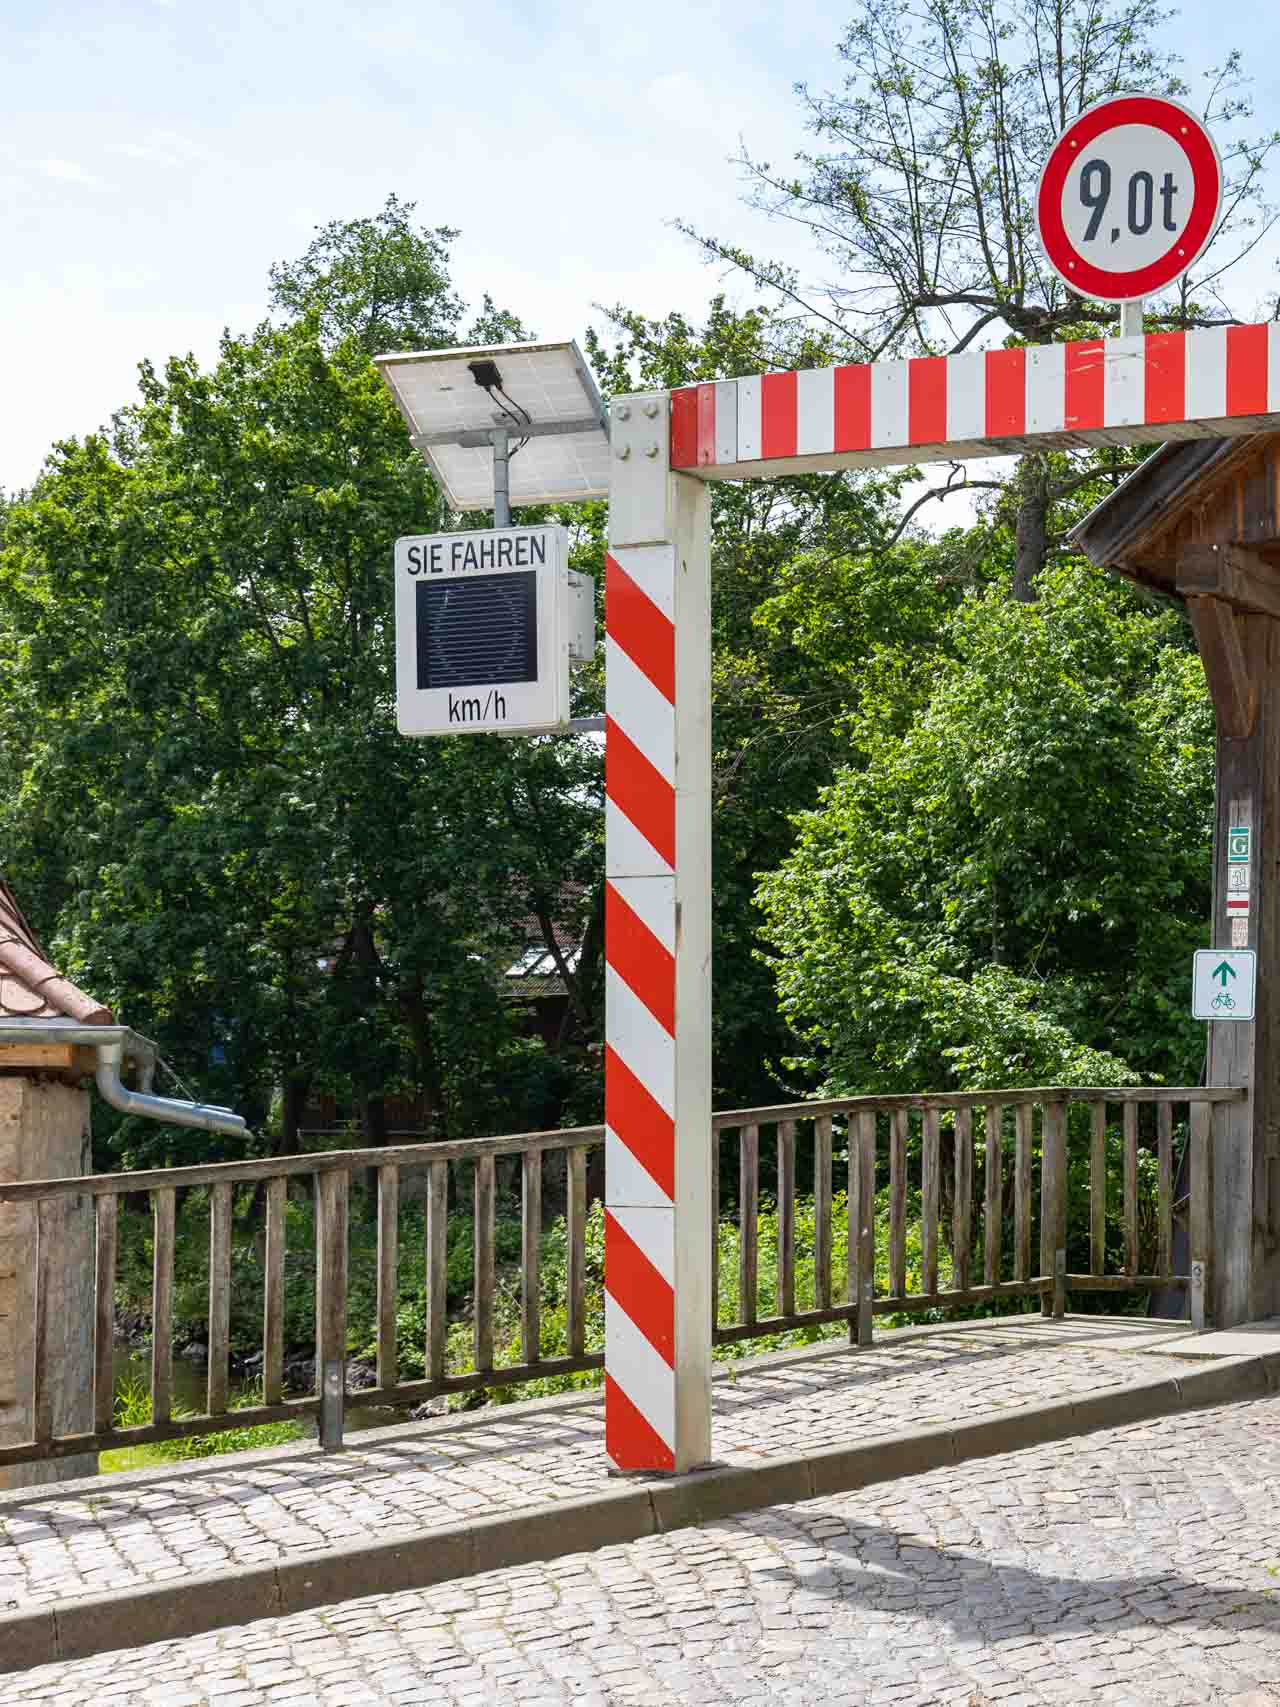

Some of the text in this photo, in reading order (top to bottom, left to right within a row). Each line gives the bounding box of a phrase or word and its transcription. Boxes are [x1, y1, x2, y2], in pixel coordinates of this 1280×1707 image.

[1079, 159, 1178, 245] 9,0t
[407, 535, 546, 576] SIE FAHREN
[448, 690, 506, 723] km/h
[1231, 837, 1248, 855] G
